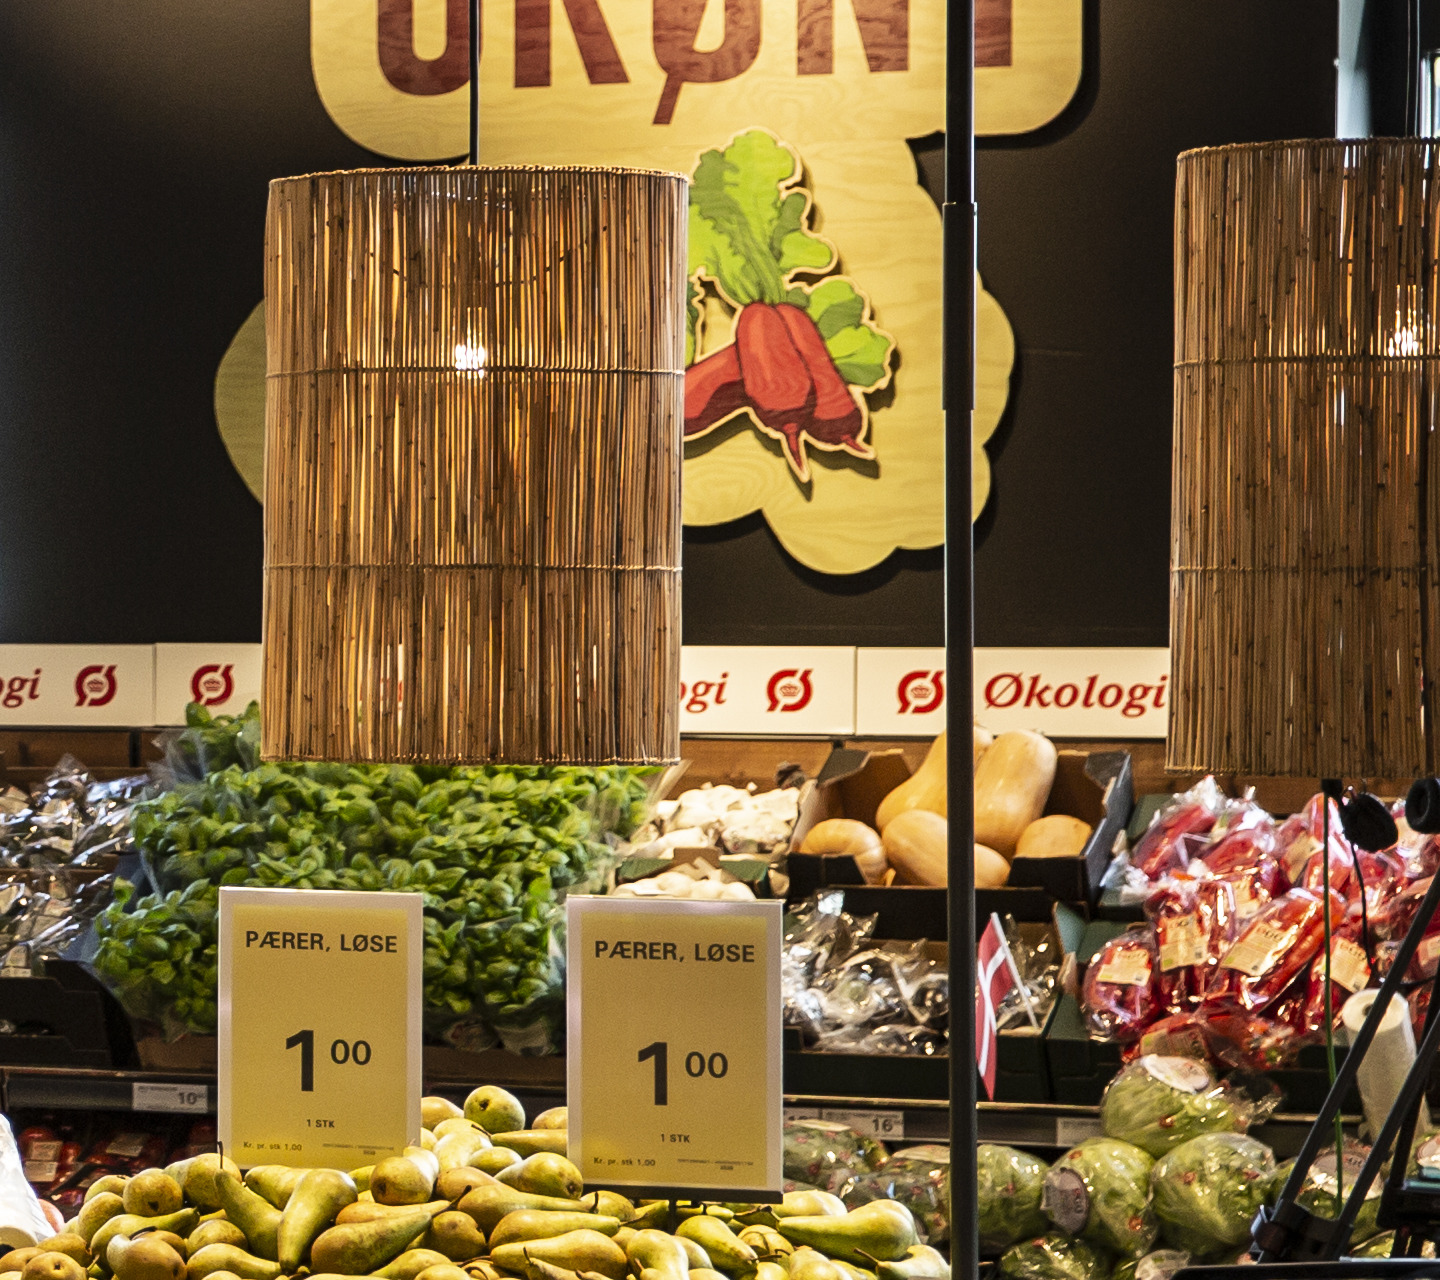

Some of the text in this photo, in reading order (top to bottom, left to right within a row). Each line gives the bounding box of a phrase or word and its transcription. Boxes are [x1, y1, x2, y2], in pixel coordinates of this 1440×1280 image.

[983, 671, 1169, 718] Økologi
[246, 930, 398, 953] PÆRER, LØSE
[595, 939, 755, 963] PÆRER, LØSE
